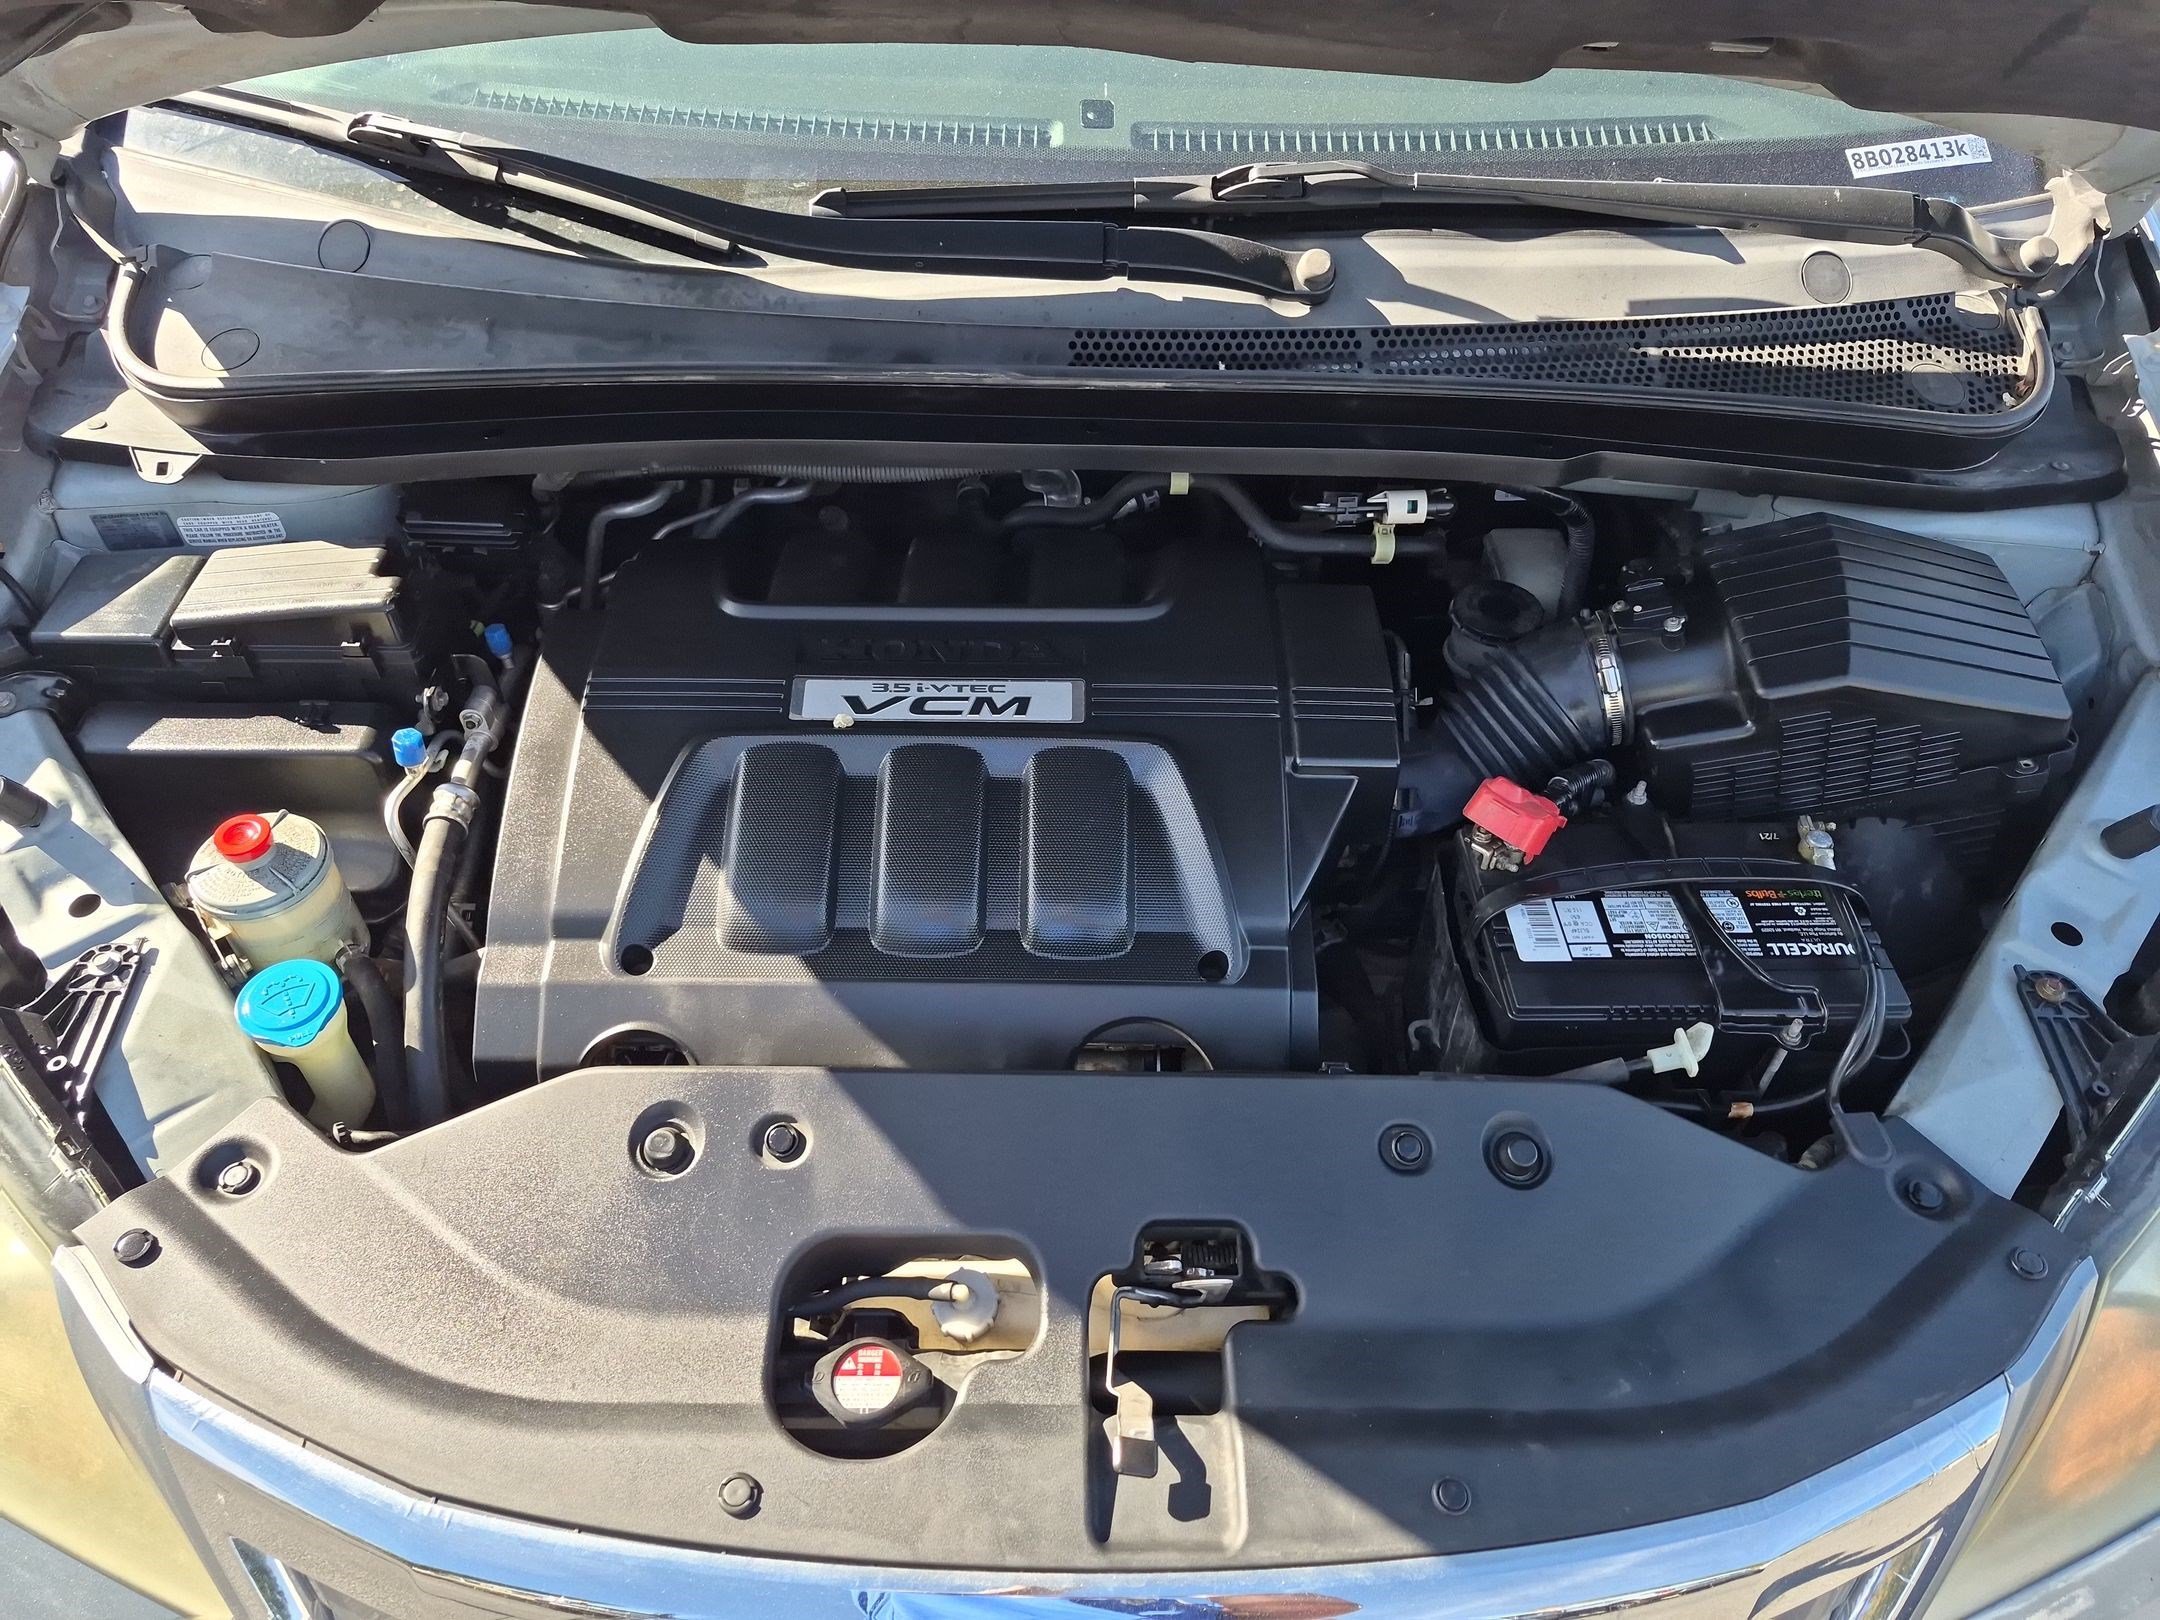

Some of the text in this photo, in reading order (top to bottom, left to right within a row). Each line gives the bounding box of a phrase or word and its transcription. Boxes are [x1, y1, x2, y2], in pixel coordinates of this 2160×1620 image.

[1851, 139, 1970, 170] 8B028413k
[871, 683, 1006, 693] 3.5 i-VTEC
[841, 695, 1031, 717] VCM
